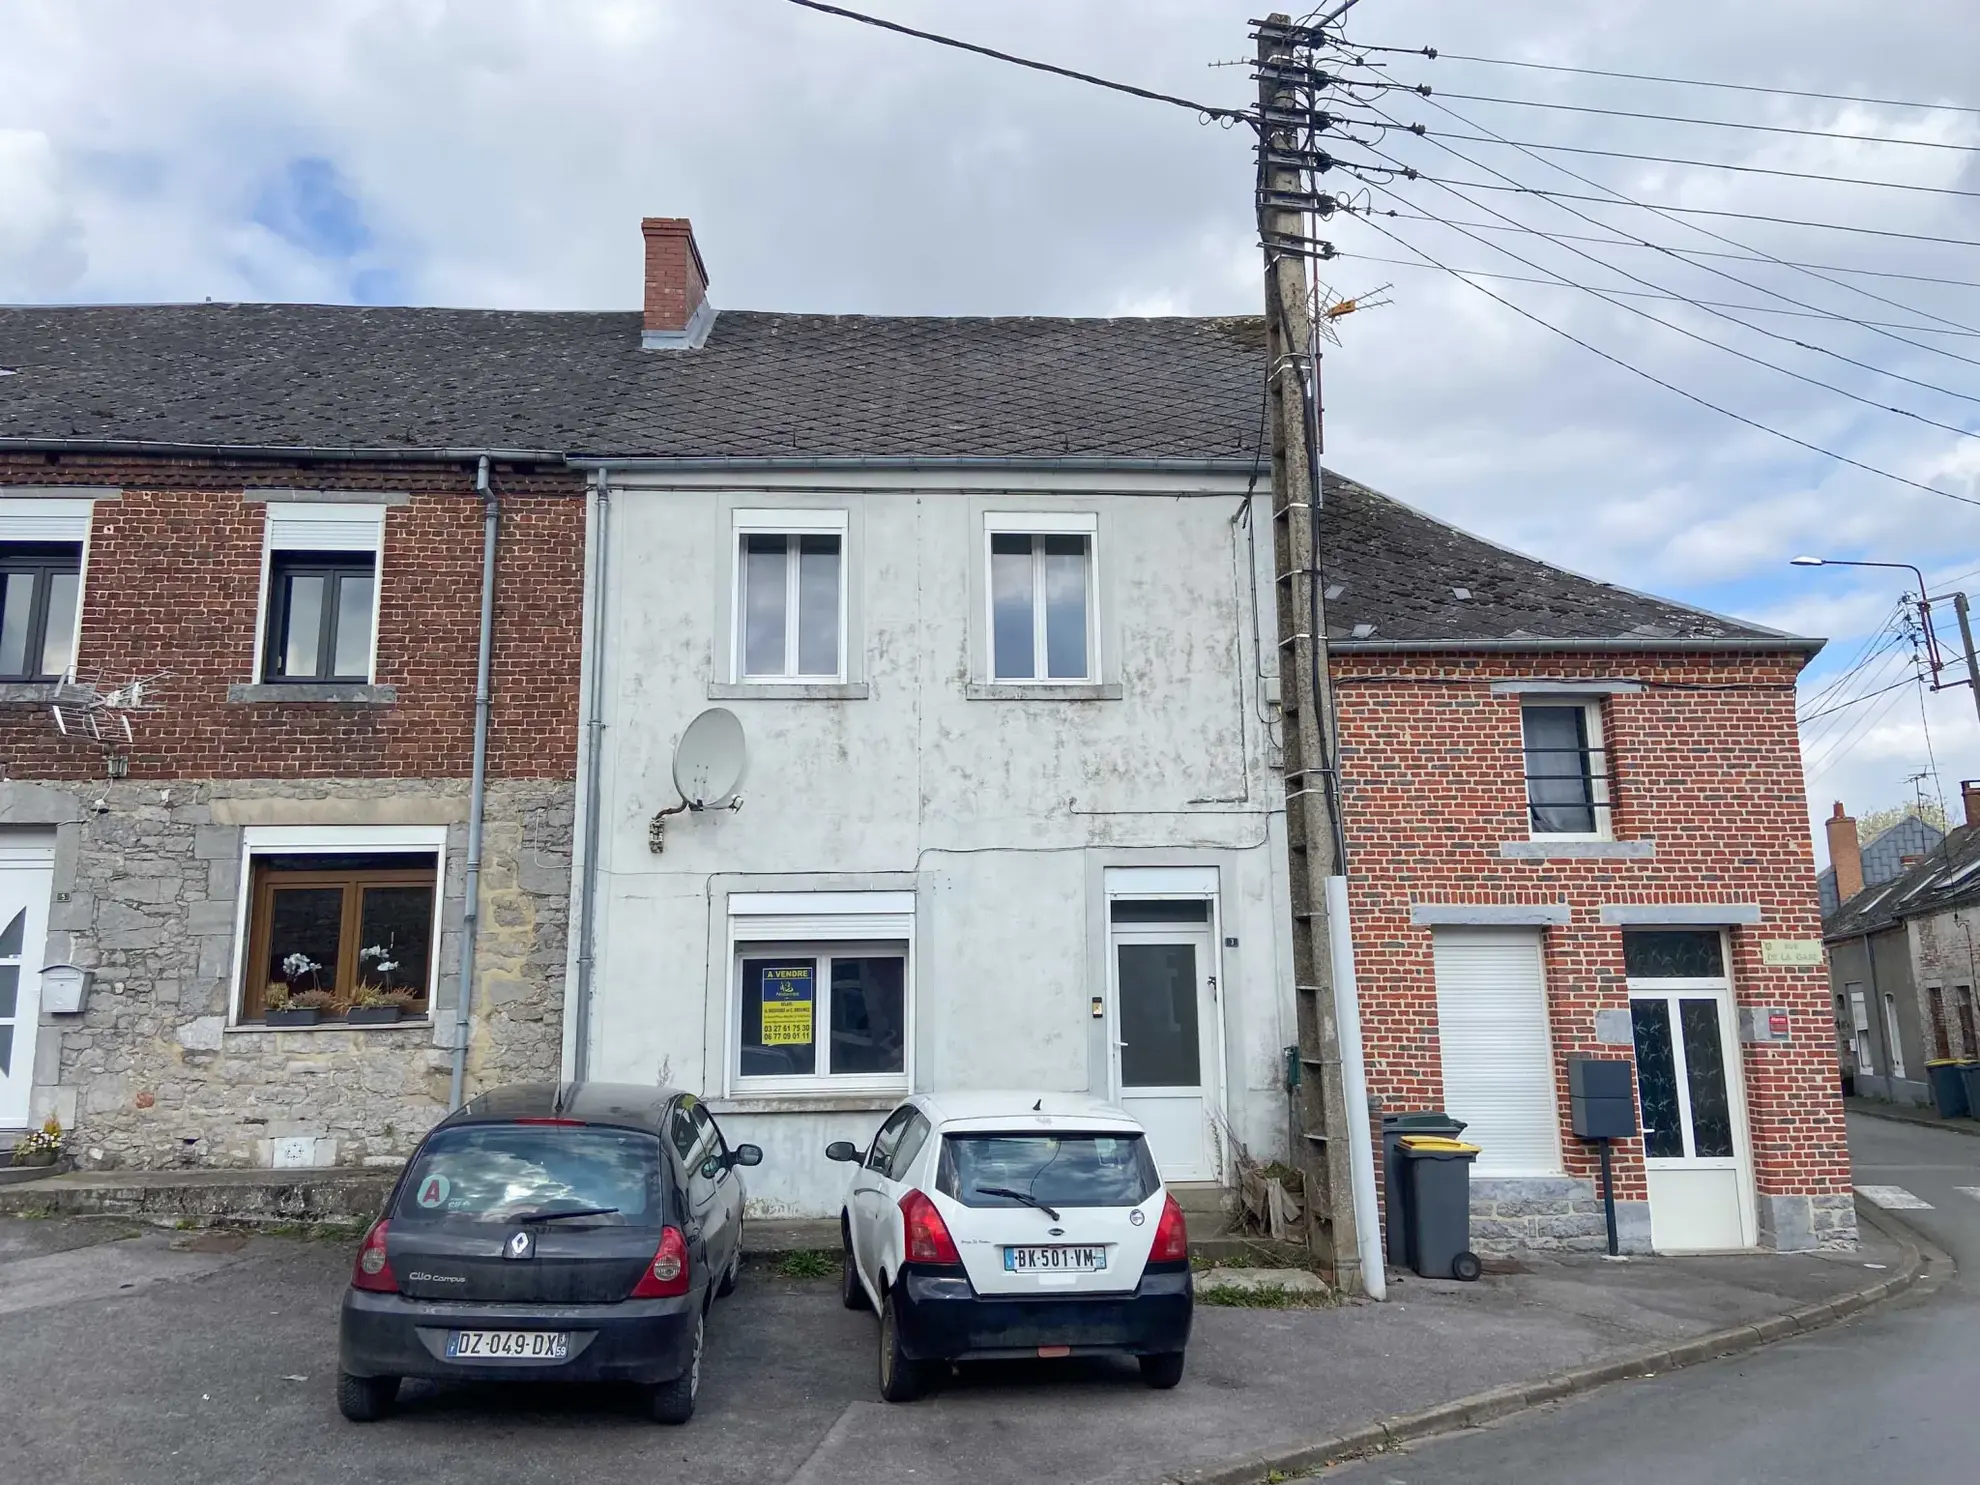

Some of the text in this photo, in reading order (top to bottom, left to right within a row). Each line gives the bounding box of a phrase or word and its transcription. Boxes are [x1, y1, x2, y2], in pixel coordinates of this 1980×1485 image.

[1781, 953, 1792, 961] LA
[783, 1024, 790, 1032] 61
[793, 1024, 801, 1032] 75
[423, 1179, 440, 1202] A
[458, 1333, 566, 1356] DZ-049-DX 59
